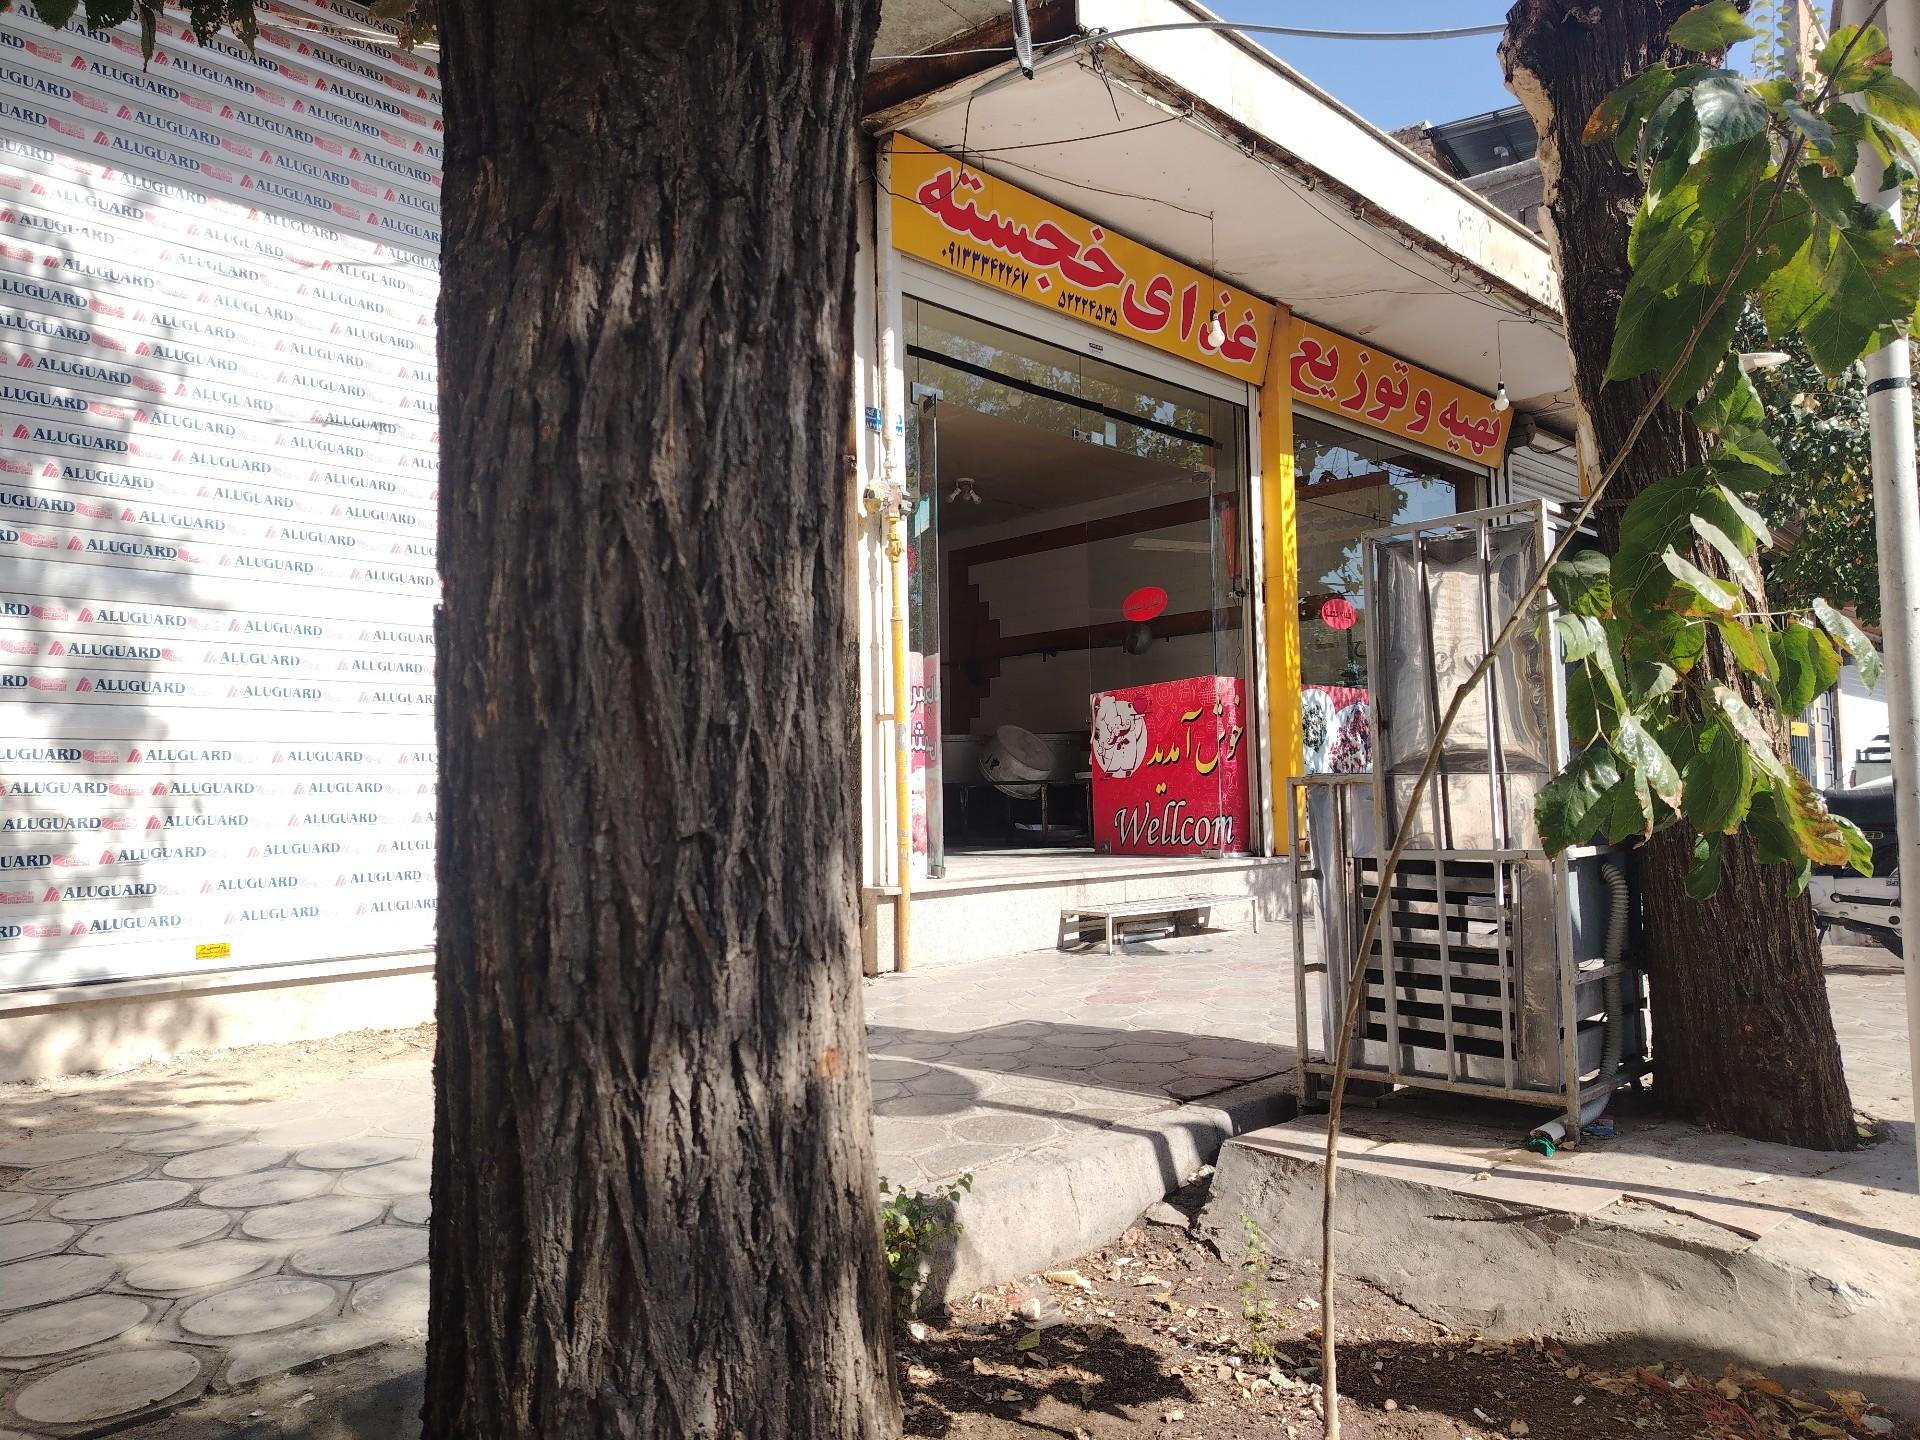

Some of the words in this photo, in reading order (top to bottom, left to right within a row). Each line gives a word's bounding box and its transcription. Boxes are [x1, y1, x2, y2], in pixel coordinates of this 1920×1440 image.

[330, 2, 399, 36] ALUGUARD
[171, 56, 255, 94] ALUGUARD
[312, 49, 384, 82] ALUGUARD
[90, 63, 179, 99] ALUGUARD
[330, 84, 400, 115] ALUGUARD
[136, 111, 220, 146] ALUGUARD
[237, 111, 313, 143] ALUGUARD
[308, 105, 379, 137] ALUGUARD
[113, 137, 200, 171] ALUGUARD
[277, 155, 350, 187] ALUGUARD
[364, 152, 431, 184] ALUGUARD
[120, 173, 207, 205] ALUGUARD
[256, 179, 332, 210] ALUGUARD
[398, 194, 441, 214] ALUGU
[263, 213, 338, 242] ALUGUARD
[380, 217, 441, 243] ALUGUAR
[917, 167, 1126, 293] خجسته
[204, 227, 283, 259] ALUGUARD
[63, 258, 154, 288] ALUGUARD
[336, 264, 405, 290] ALUGUARD
[942, 241, 1029, 293] ۰۹۱۳۳۳۴۲۲۶۷
[0, 279, 87, 308] LUGUARD
[313, 287, 384, 314] ALUGUARD
[214, 294, 293, 323] ALUGUARD
[1122, 274, 1259, 366] غذای
[345, 326, 414, 350] ALUGUARD
[153, 346, 237, 371] ALUGUARD
[290, 343, 363, 367] ALUGUARD
[37, 357, 132, 385] ALUGUARD
[1290, 337, 1411, 424] توزیع
[292, 374, 365, 398] ALUGUARD
[0, 386, 88, 411] LUGUARD
[193, 386, 273, 411] ALUGUARD
[152, 409, 235, 435] ALUGUARD
[1406, 388, 1433, 434] و
[1438, 398, 1502, 456] تهیه
[33, 428, 128, 453] ALUGUARD
[290, 436, 363, 458] ALUGUARD
[190, 451, 271, 473] ALUGUARD
[62, 466, 154, 489] ALUGUARD
[325, 473, 396, 494] ALUGUARD
[214, 488, 293, 508] ALUGUARD
[139, 511, 225, 531] ALUGUARD
[345, 507, 416, 525] ALUGUARD
[86, 539, 177, 559] ALUGUARD
[281, 529, 355, 546] ALUGUARD
[236, 555, 313, 573] ALUGUARD
[365, 569, 433, 586] ALUGUARD
[97, 610, 186, 626] ALUGUARD
[244, 621, 322, 636] ALUGUARD
[373, 631, 434, 644] ALUGUAR
[69, 643, 160, 659] ALUGUARD
[221, 651, 299, 666] ALUGUARD
[352, 660, 422, 674] ALUGUARD
[94, 678, 185, 694] ALUGUARD
[243, 686, 321, 700] ALUGUARD
[373, 692, 434, 704] ALUGUAR
[146, 750, 231, 761] ALUGUARD
[288, 751, 362, 762] ALUGUARD
[1147, 706, 1203, 794] آمدید
[11, 782, 107, 794] ALUGUARD
[170, 782, 254, 794] ALUGUARD
[309, 783, 382, 793] ALUGUARD
[3, 818, 100, 830] ALUGUARD
[164, 815, 248, 826] ALUGUARD
[304, 813, 377, 824] ALUGUARD
[1114, 800, 1234, 847] Wellcom
[118, 847, 206, 861] ALUGUARD
[264, 843, 340, 855] ALUGUARD
[391, 840, 433, 851] ALUGU
[218, 876, 298, 890] ALUGUARD
[350, 871, 421, 884] ALUGUARD
[64, 884, 157, 898] ALUGUARD
[89, 915, 181, 931] ALUGUARD
[240, 907, 319, 921] ALUGUARD
